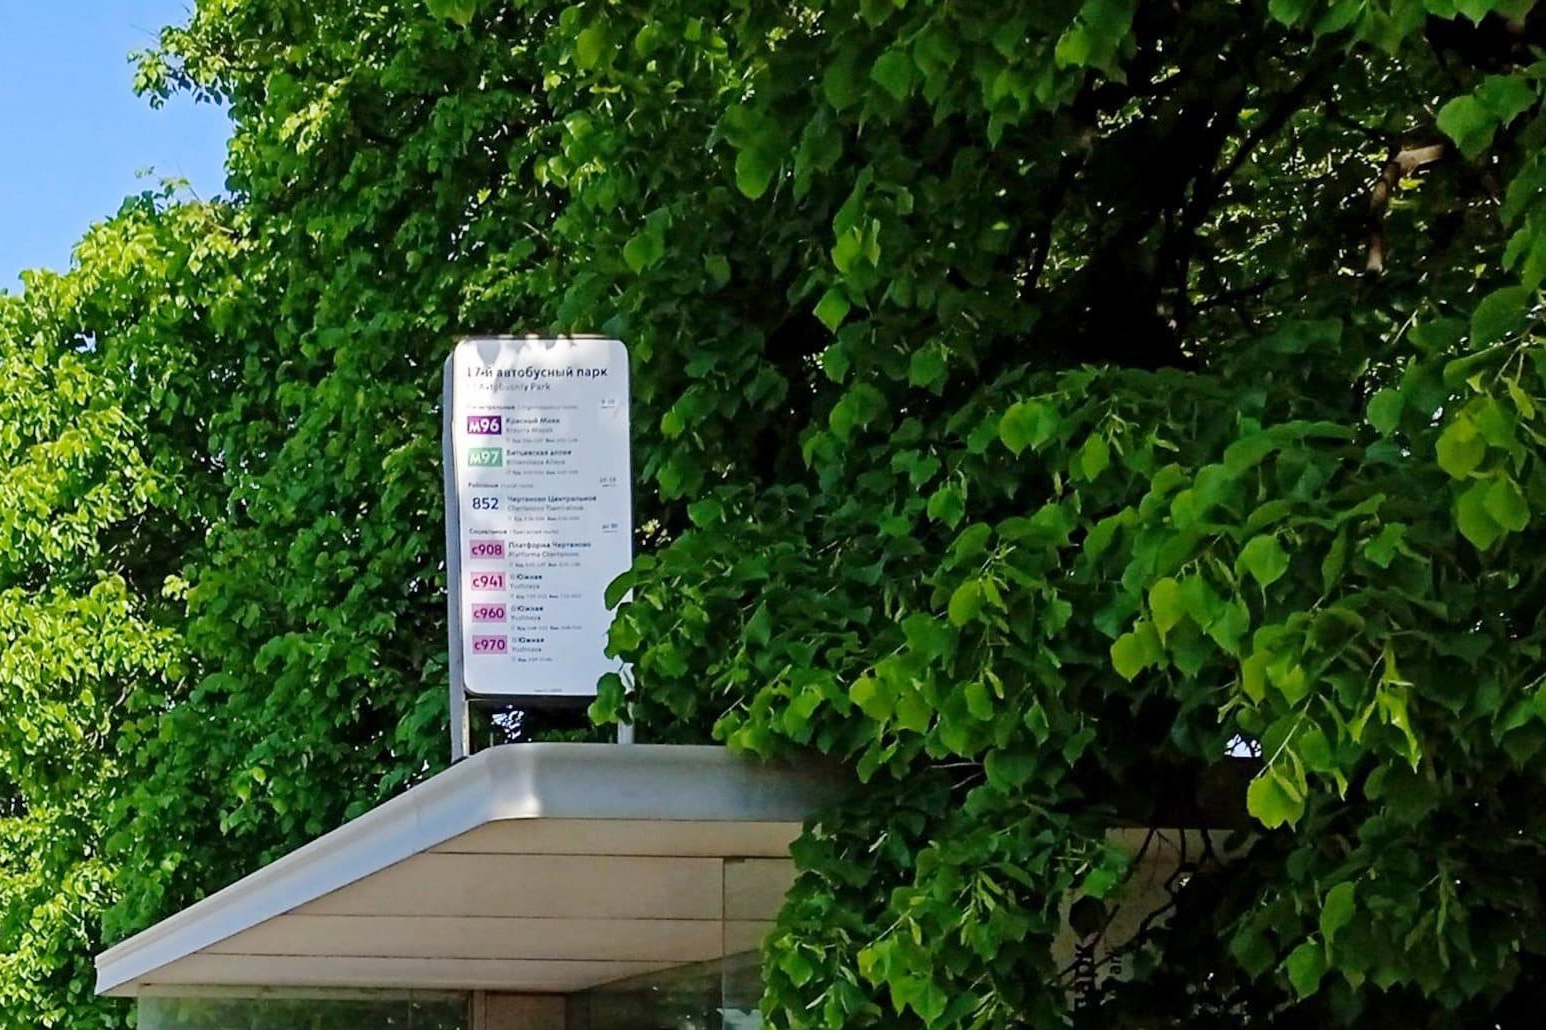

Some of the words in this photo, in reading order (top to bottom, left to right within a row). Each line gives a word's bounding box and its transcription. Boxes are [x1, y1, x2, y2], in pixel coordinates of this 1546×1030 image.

[496, 365, 574, 381] автобусный
[576, 367, 608, 380] парк
[472, 496, 499, 510] 852
